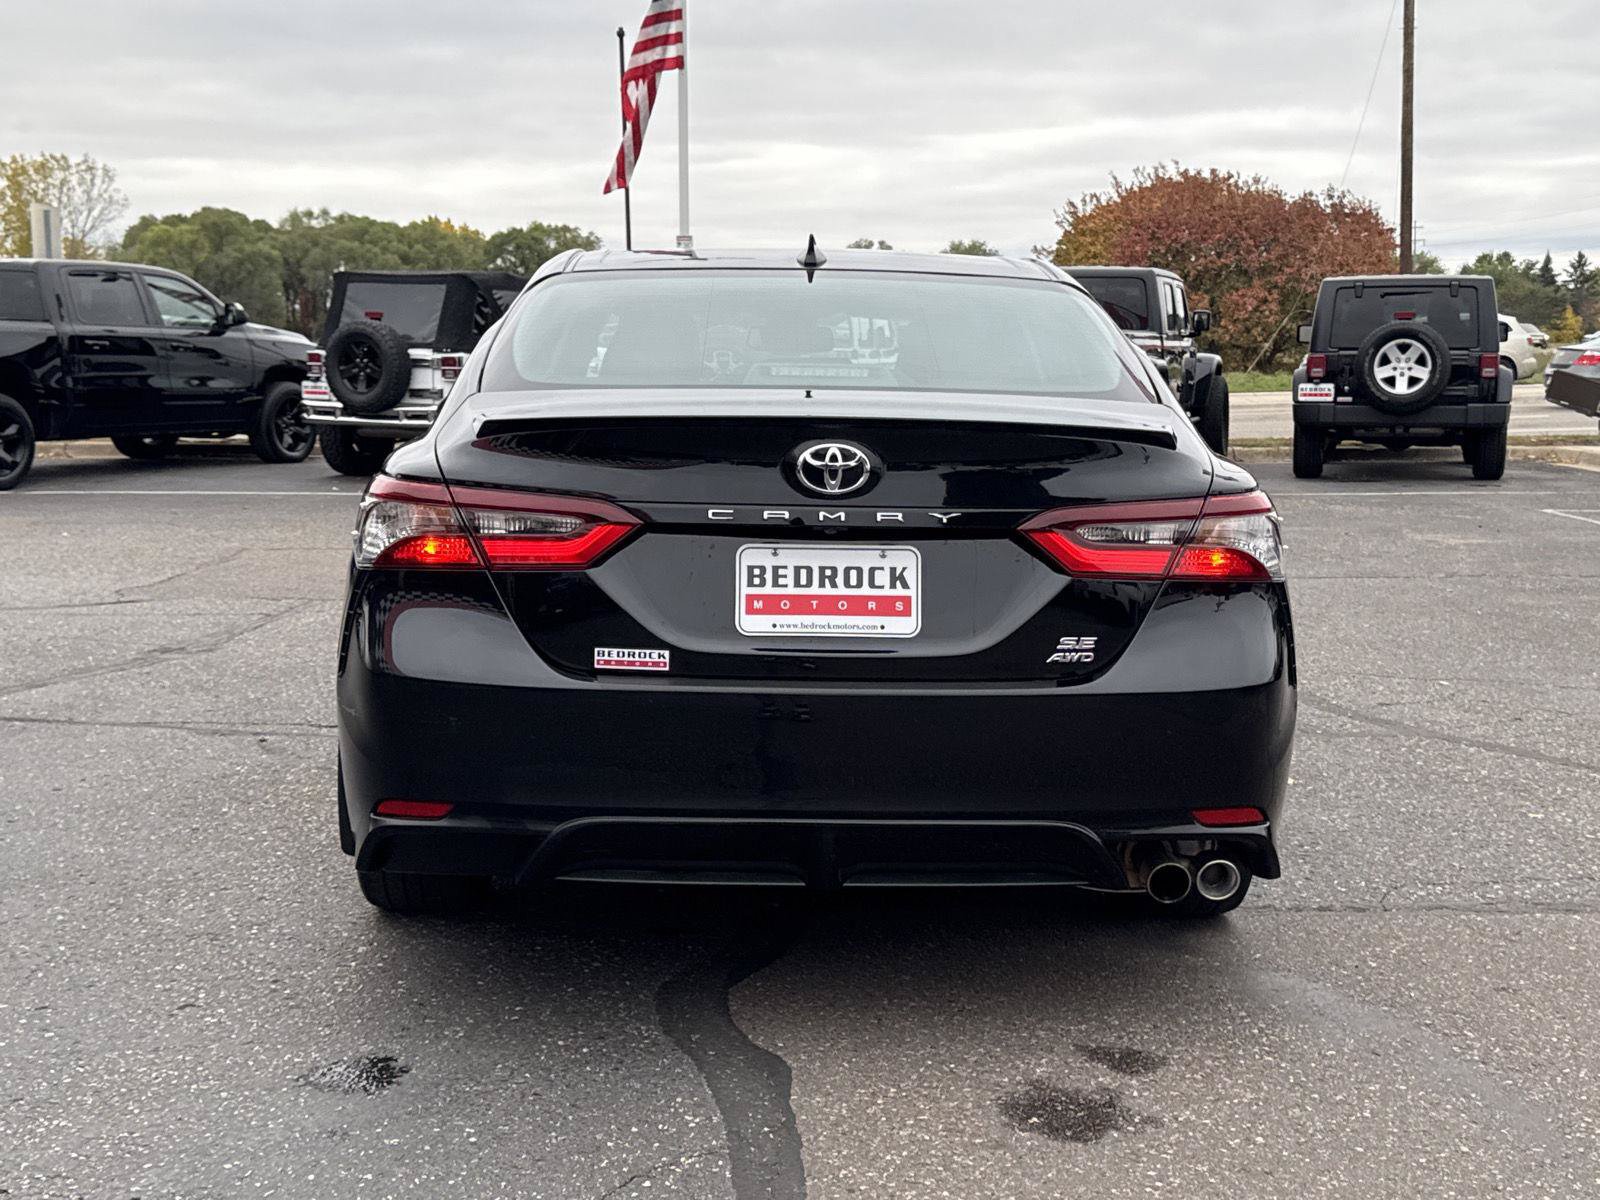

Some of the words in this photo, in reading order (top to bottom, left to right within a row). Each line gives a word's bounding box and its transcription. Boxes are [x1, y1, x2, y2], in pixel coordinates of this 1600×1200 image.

[707, 507, 962, 523] CAMRY
[746, 565, 910, 589] BEDROCK
[753, 600, 904, 612] MOTORS
[778, 622, 879, 632] www.bedrockmotors.com
[1056, 636, 1098, 649] SE
[597, 650, 667, 659] BEDROCK
[1046, 652, 1095, 663] AWD
